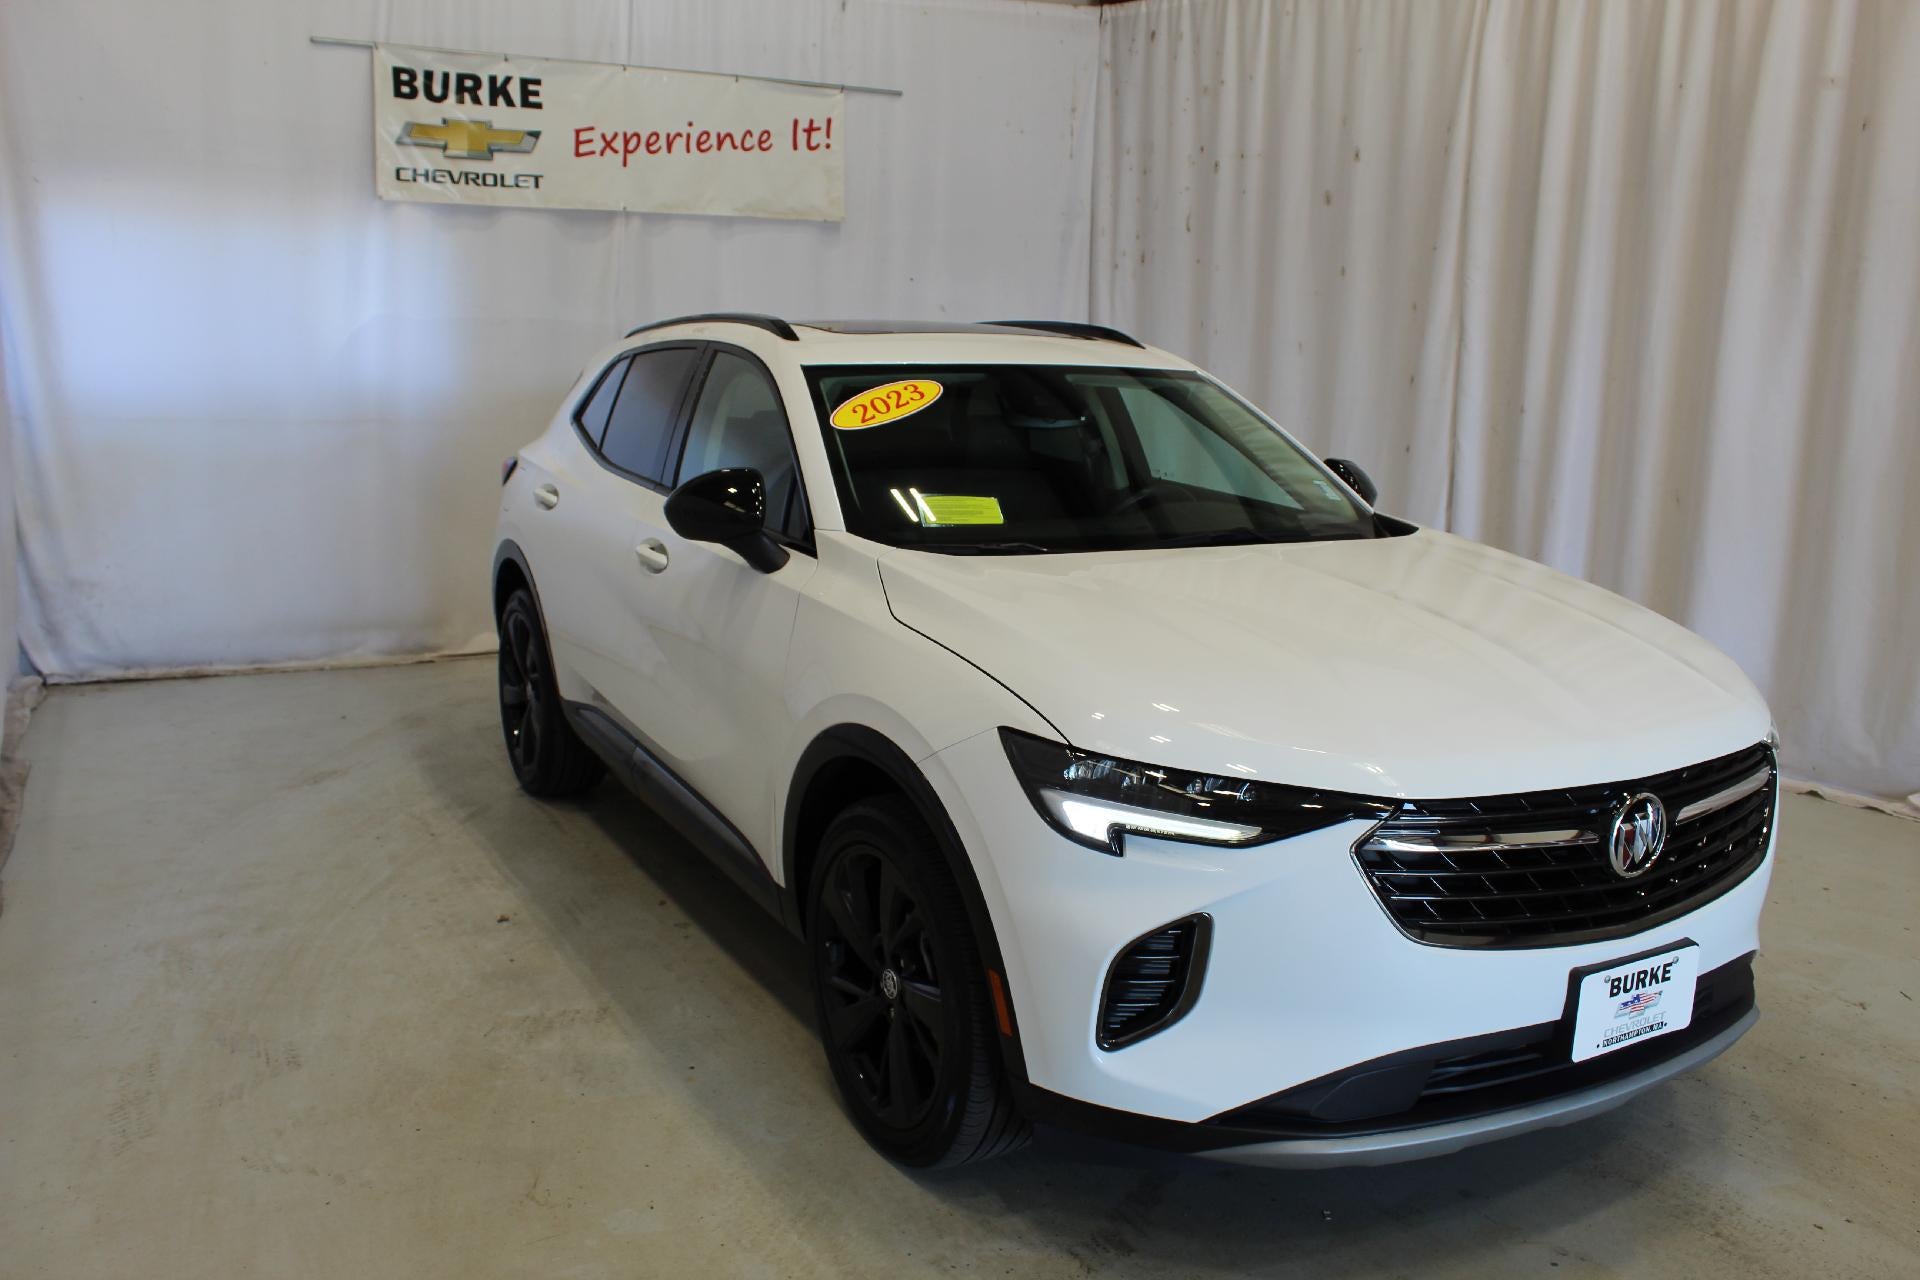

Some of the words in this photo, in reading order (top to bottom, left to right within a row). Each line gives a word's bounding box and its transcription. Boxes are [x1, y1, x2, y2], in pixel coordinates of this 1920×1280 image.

[392, 66, 543, 109] BURKE
[574, 121, 773, 168] Experience
[792, 117, 832, 151] It!
[395, 166, 544, 189] CHEVROLET
[852, 383, 926, 424] 2023
[1609, 962, 1673, 998] BURKE
[1604, 1011, 1666, 1038] CHEVROLET
[1652, 1021, 1664, 1032] MA
